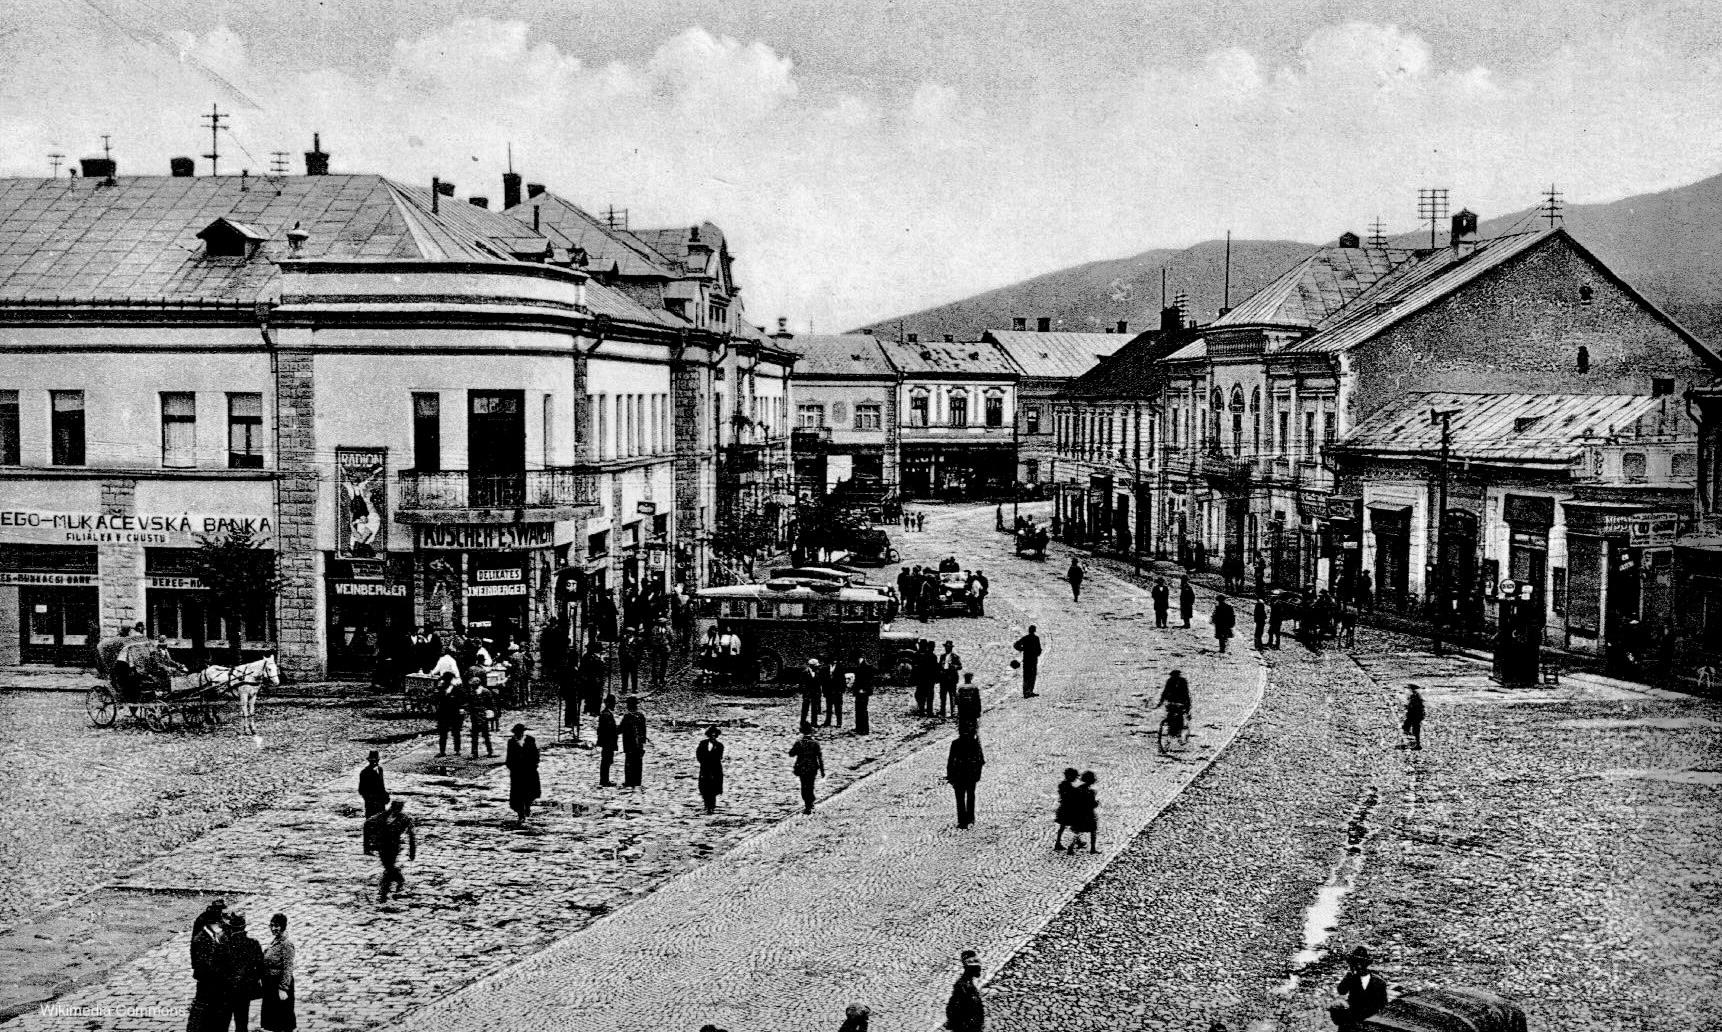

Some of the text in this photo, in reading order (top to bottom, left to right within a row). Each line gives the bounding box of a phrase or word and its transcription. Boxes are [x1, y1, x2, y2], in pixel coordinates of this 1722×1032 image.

[341, 453, 383, 467] RADION
[203, 517, 272, 534] BANKA
[126, 534, 166, 543] CHUSTU
[478, 569, 521, 581] DELIKATES
[335, 583, 407, 597] WEINBERGER
